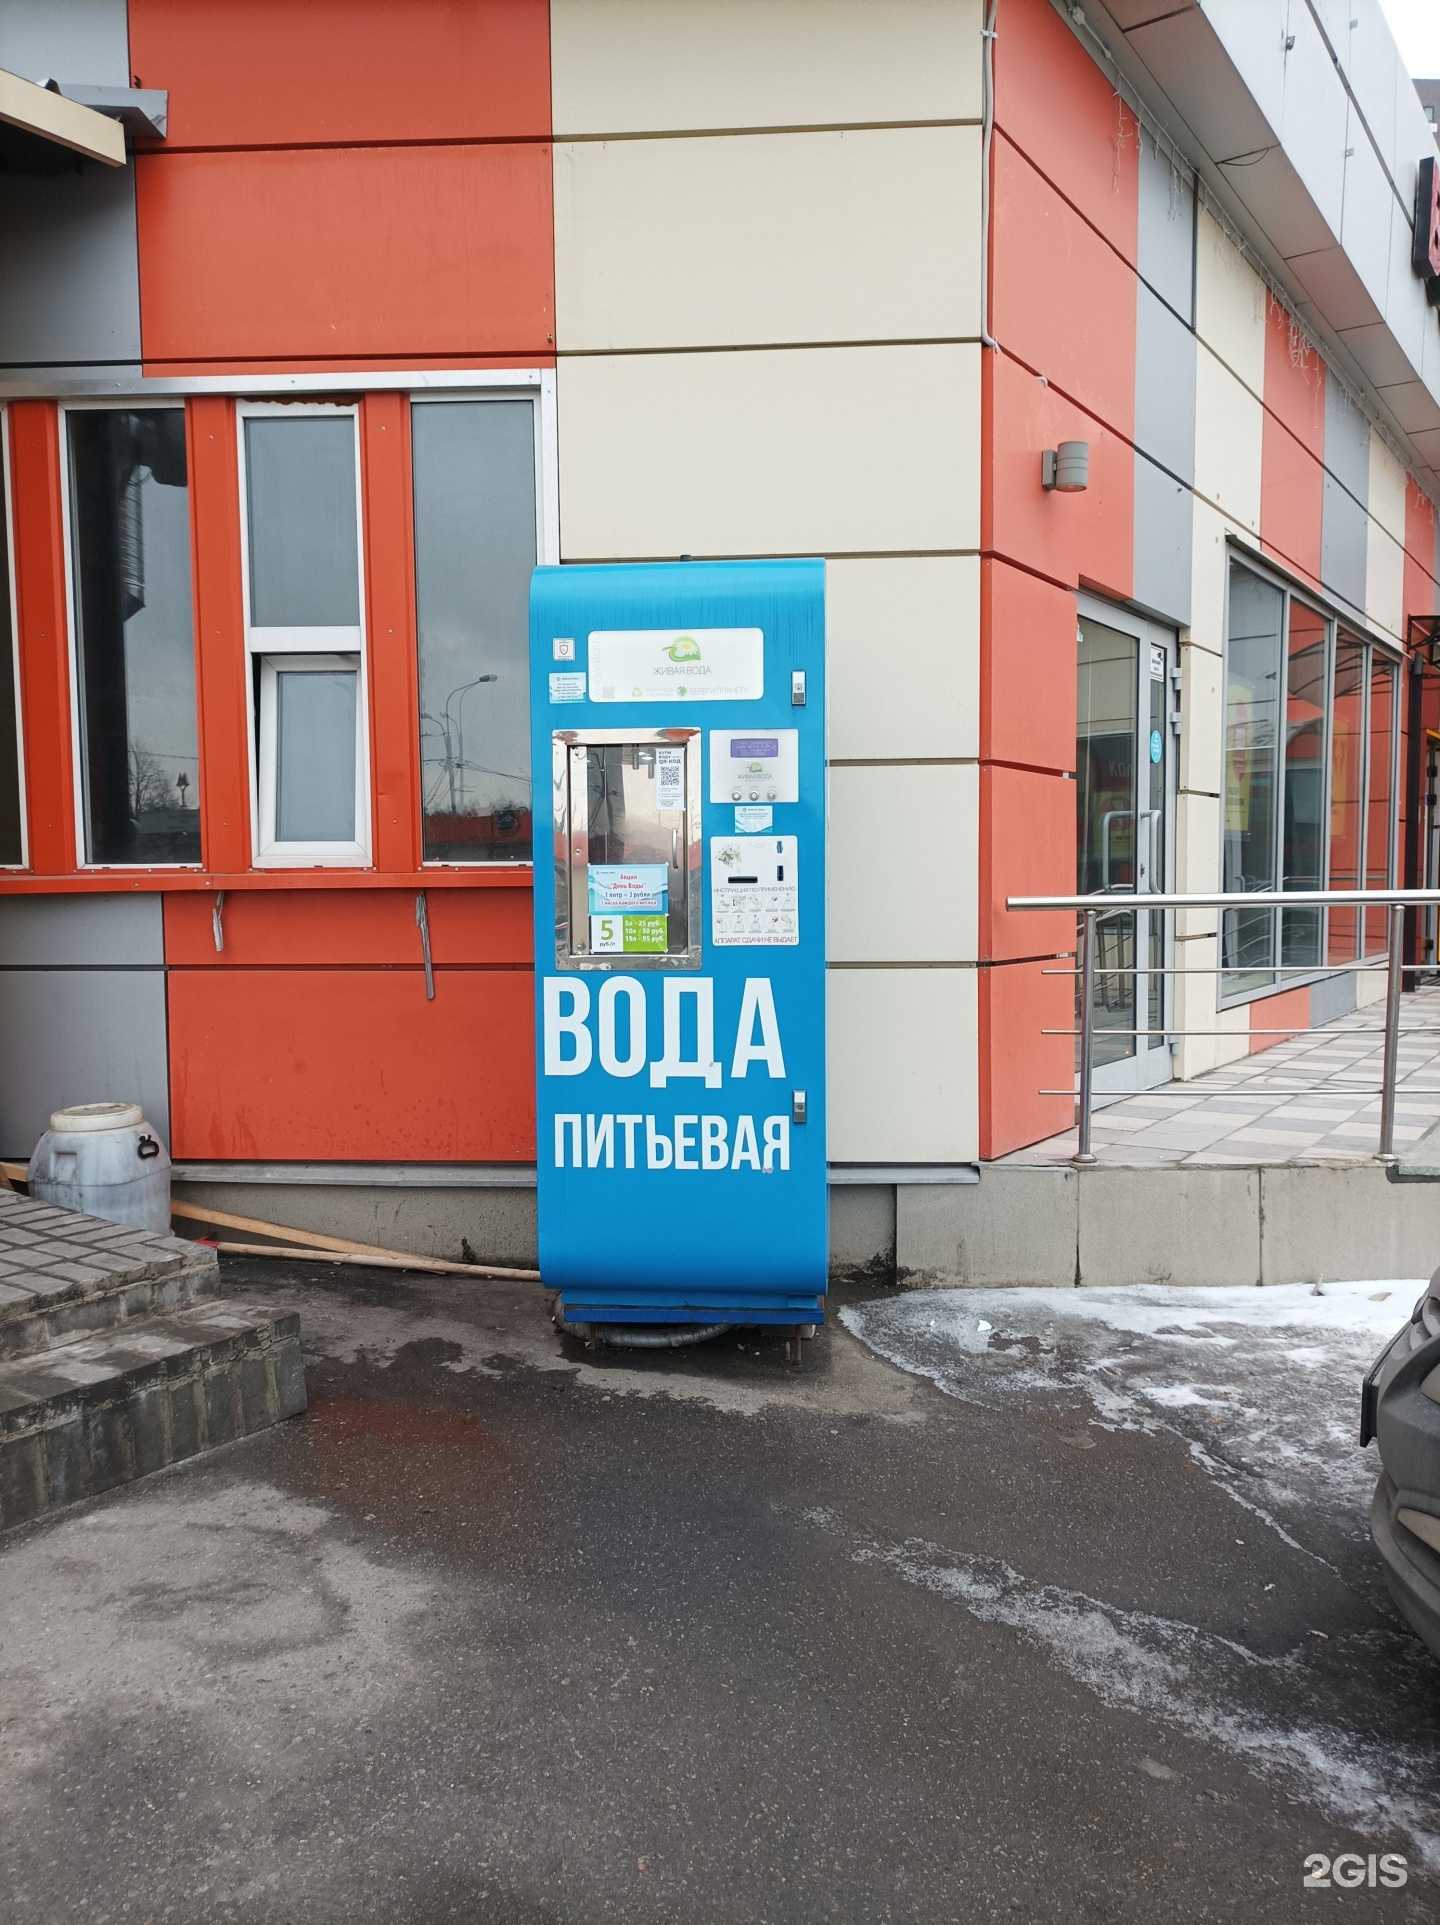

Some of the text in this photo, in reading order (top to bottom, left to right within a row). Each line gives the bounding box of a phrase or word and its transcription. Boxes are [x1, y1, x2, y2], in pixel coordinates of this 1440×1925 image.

[687, 665, 712, 675] ВОДА
[601, 919, 614, 941] 5
[543, 975, 787, 1088] ВОДА
[554, 1113, 790, 1170] ПИТЬЕВАЯ
